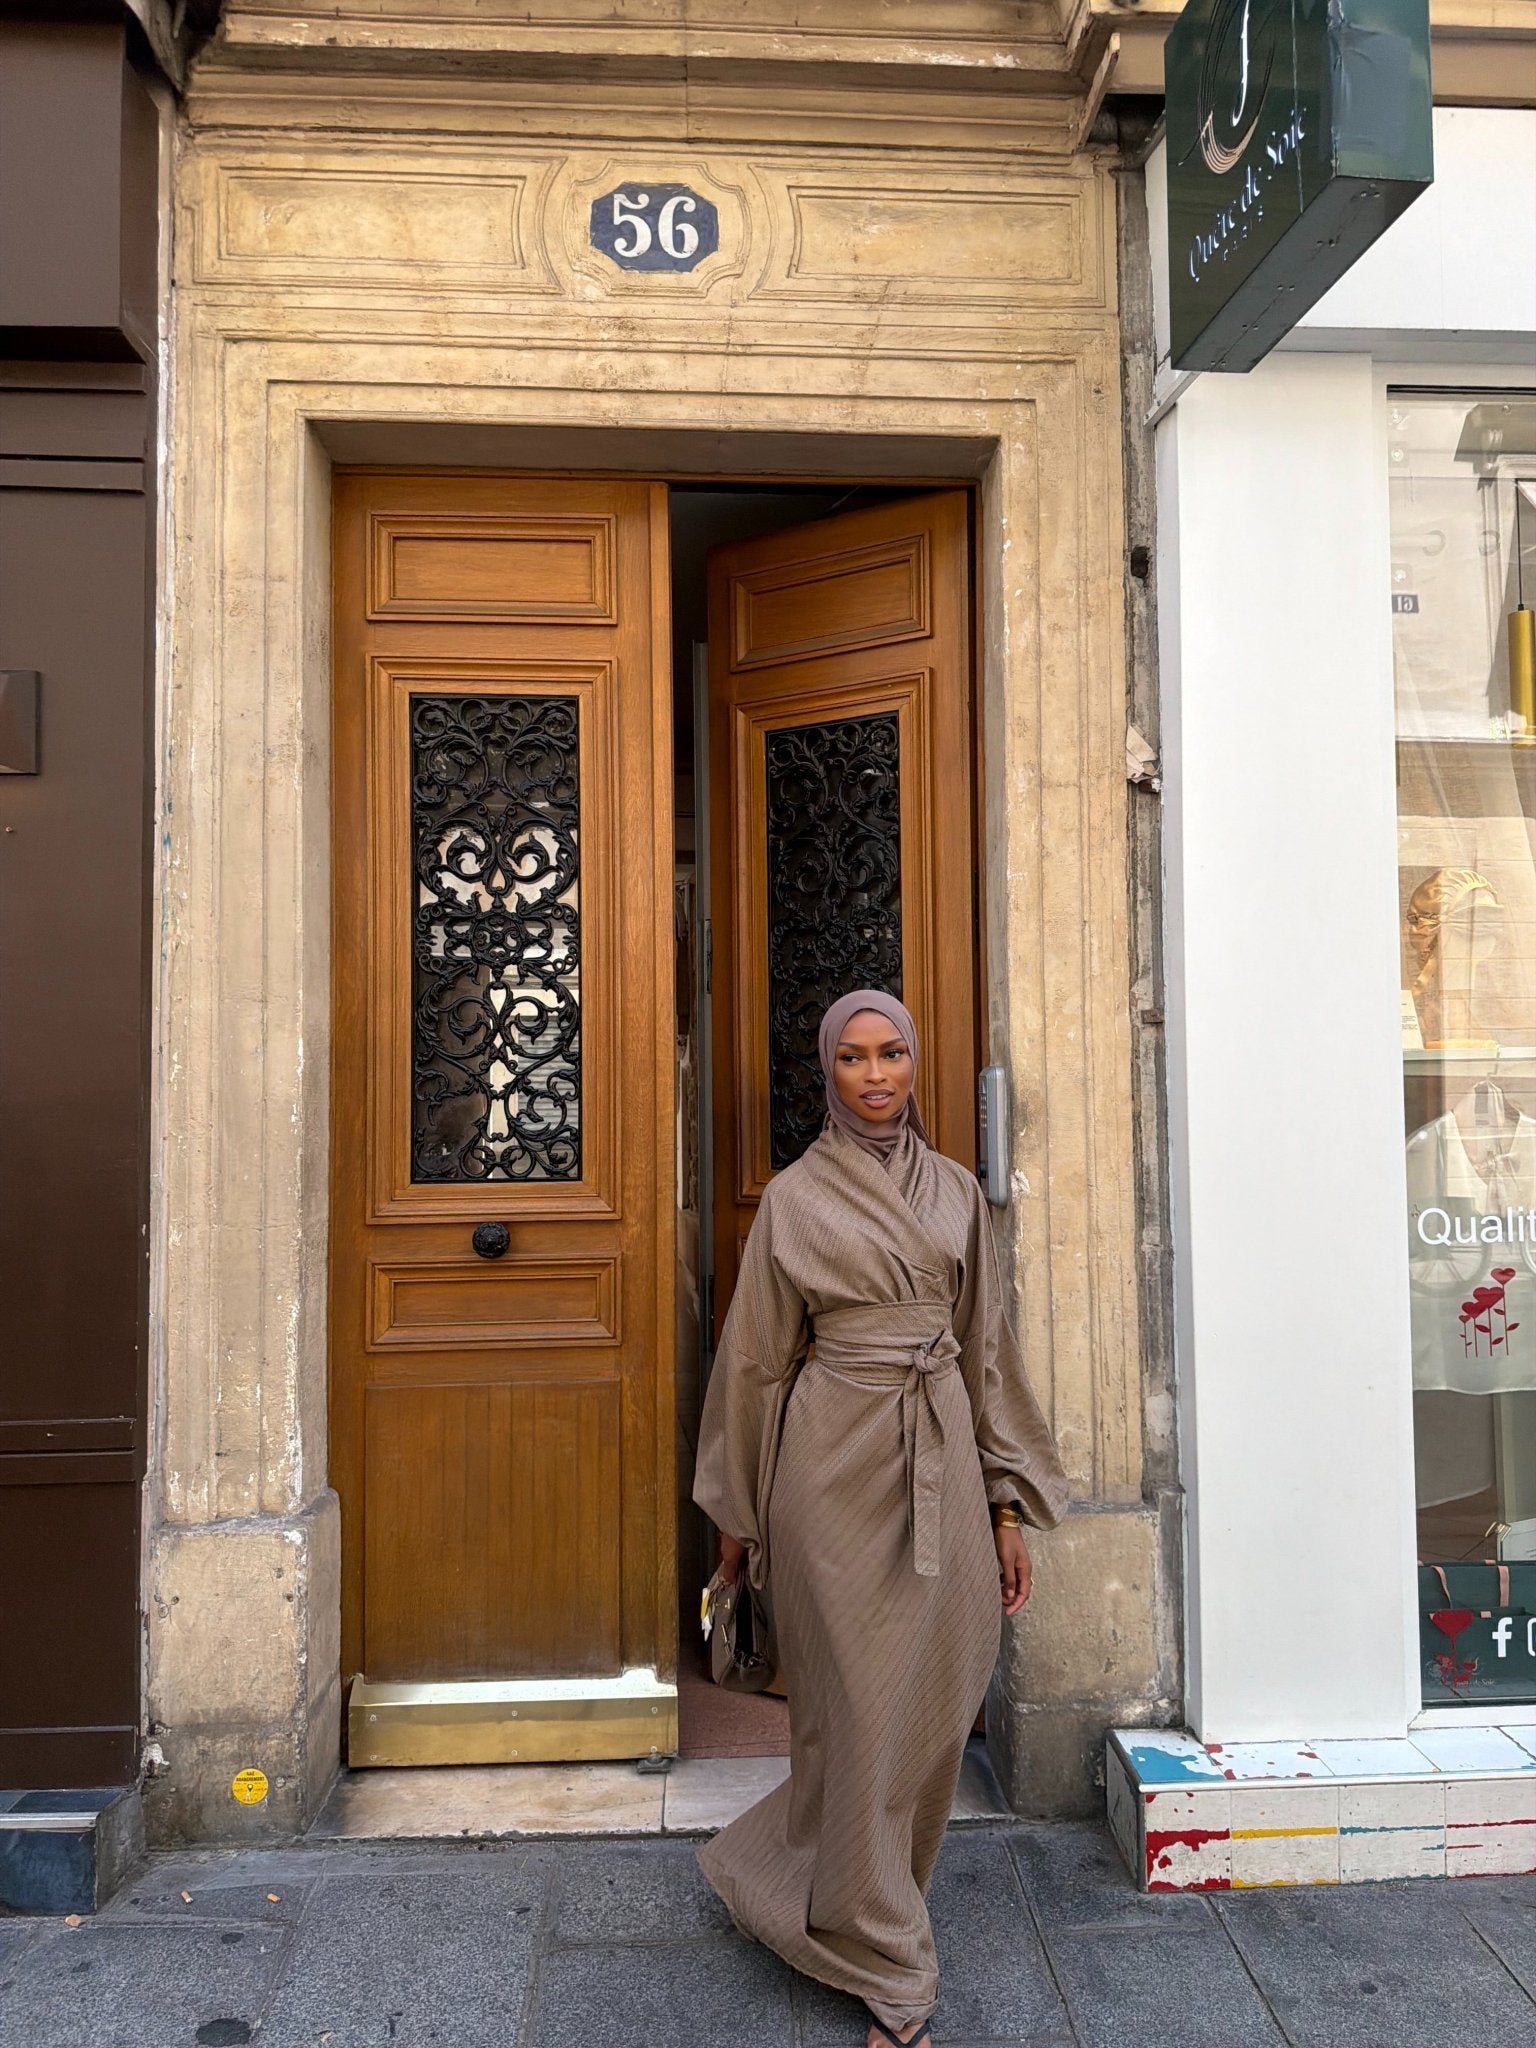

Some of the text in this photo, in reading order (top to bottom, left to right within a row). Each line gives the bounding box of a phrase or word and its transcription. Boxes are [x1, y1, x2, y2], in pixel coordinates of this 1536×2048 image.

[1240, 164, 1262, 213] de
[1266, 108, 1306, 180] Soie
[613, 193, 699, 259] 56
[1416, 1206, 1536, 1246] Qualit
